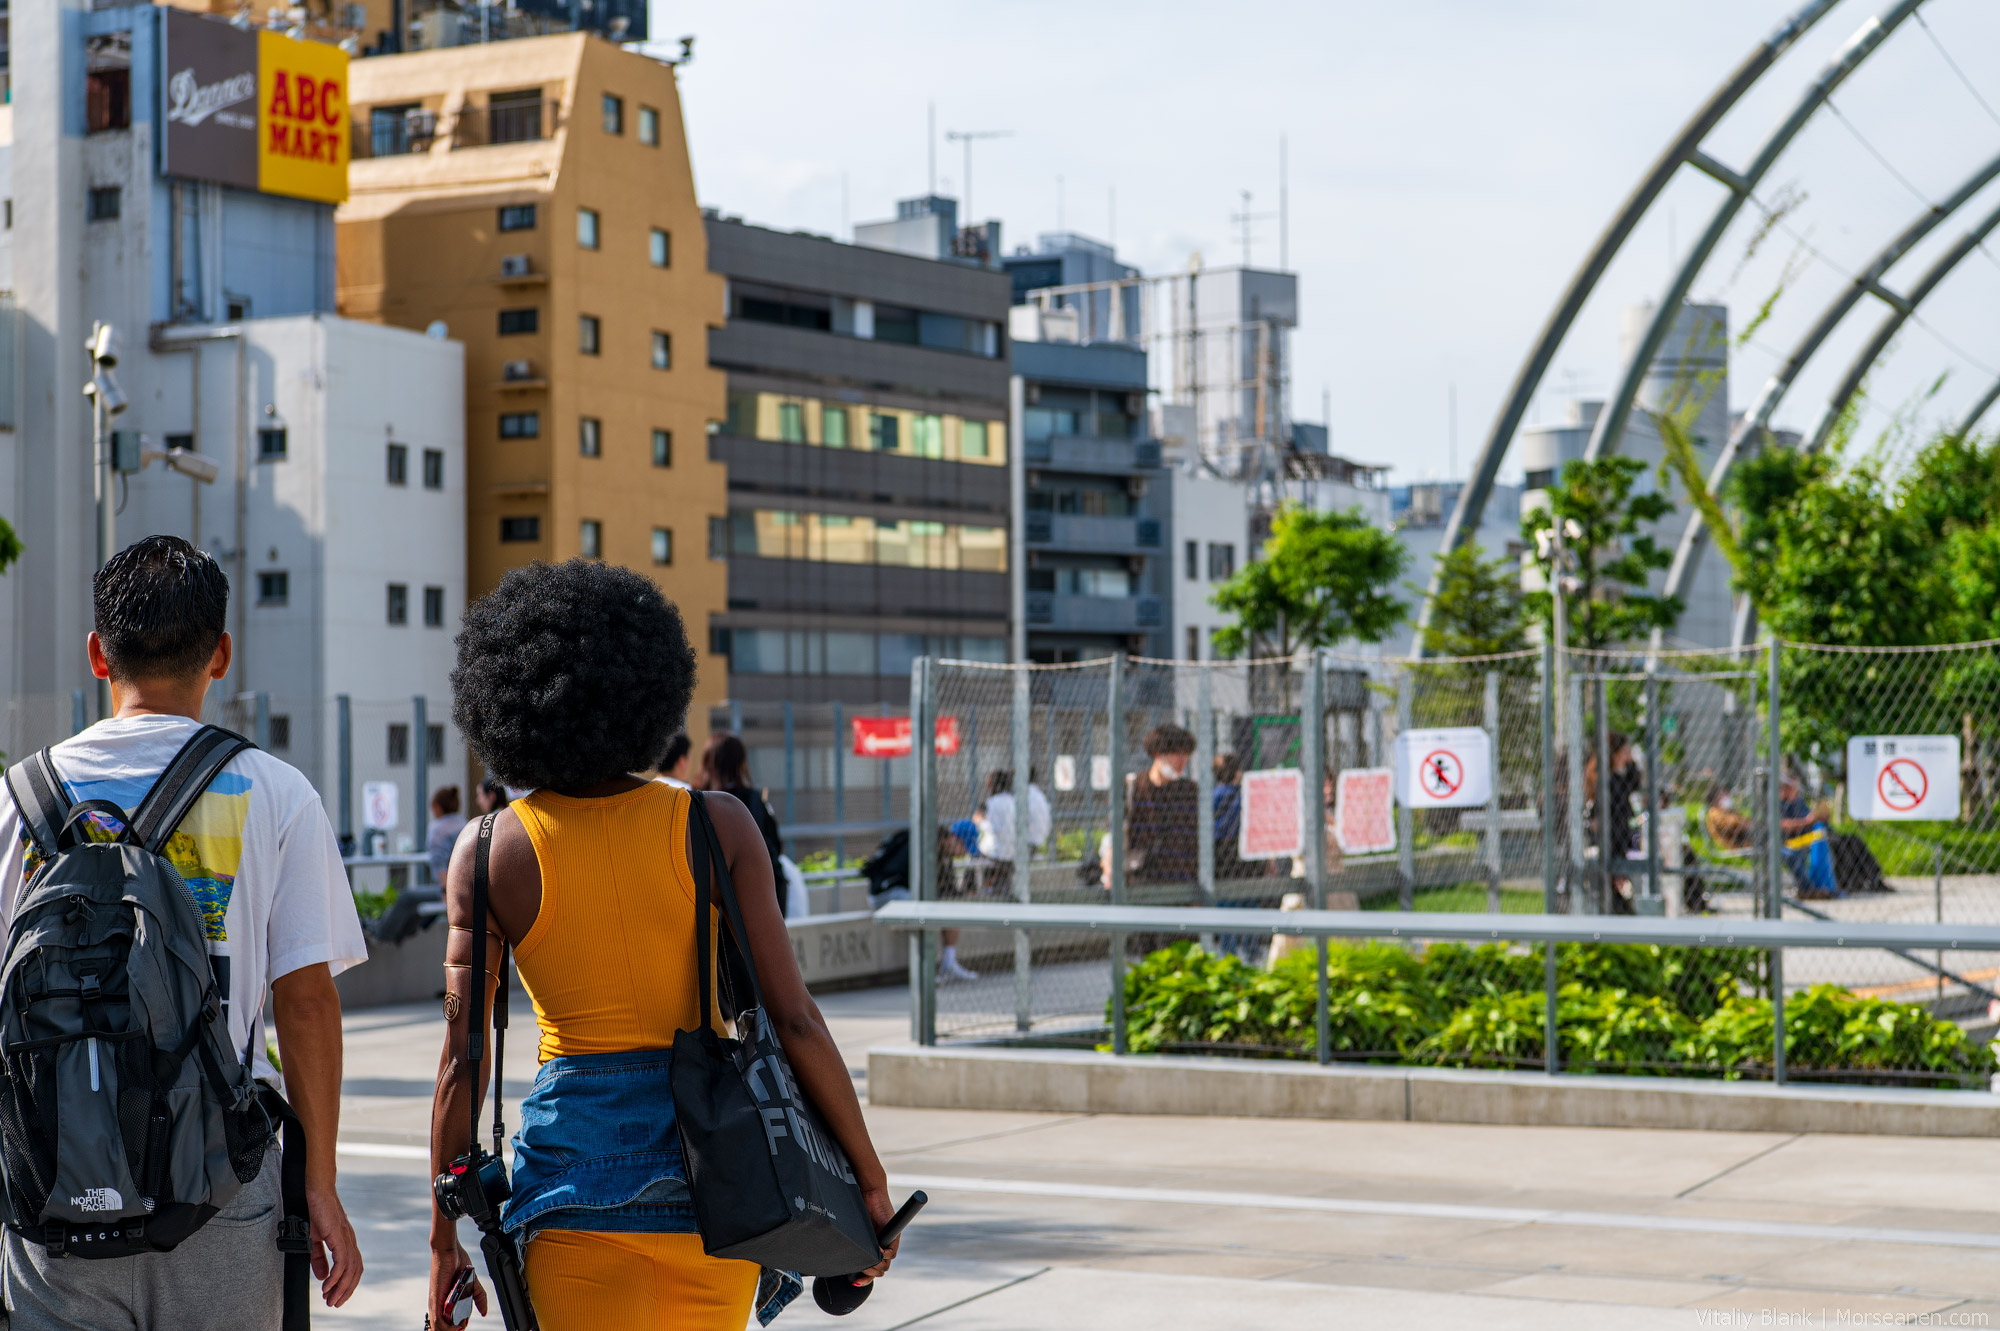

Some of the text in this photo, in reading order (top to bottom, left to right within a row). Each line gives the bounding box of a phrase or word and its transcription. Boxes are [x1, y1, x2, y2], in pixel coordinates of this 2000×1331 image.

[270, 70, 340, 126] ABC
[269, 124, 341, 165] MART
[481, 813, 494, 838] SON
[819, 929, 873, 969] PARK
[743, 1053, 806, 1113] THE
[759, 1106, 858, 1185] FUTURE
[71, 1196, 104, 1206] NORTH
[81, 1204, 105, 1212] FACE
[85, 1188, 104, 1197] THE
